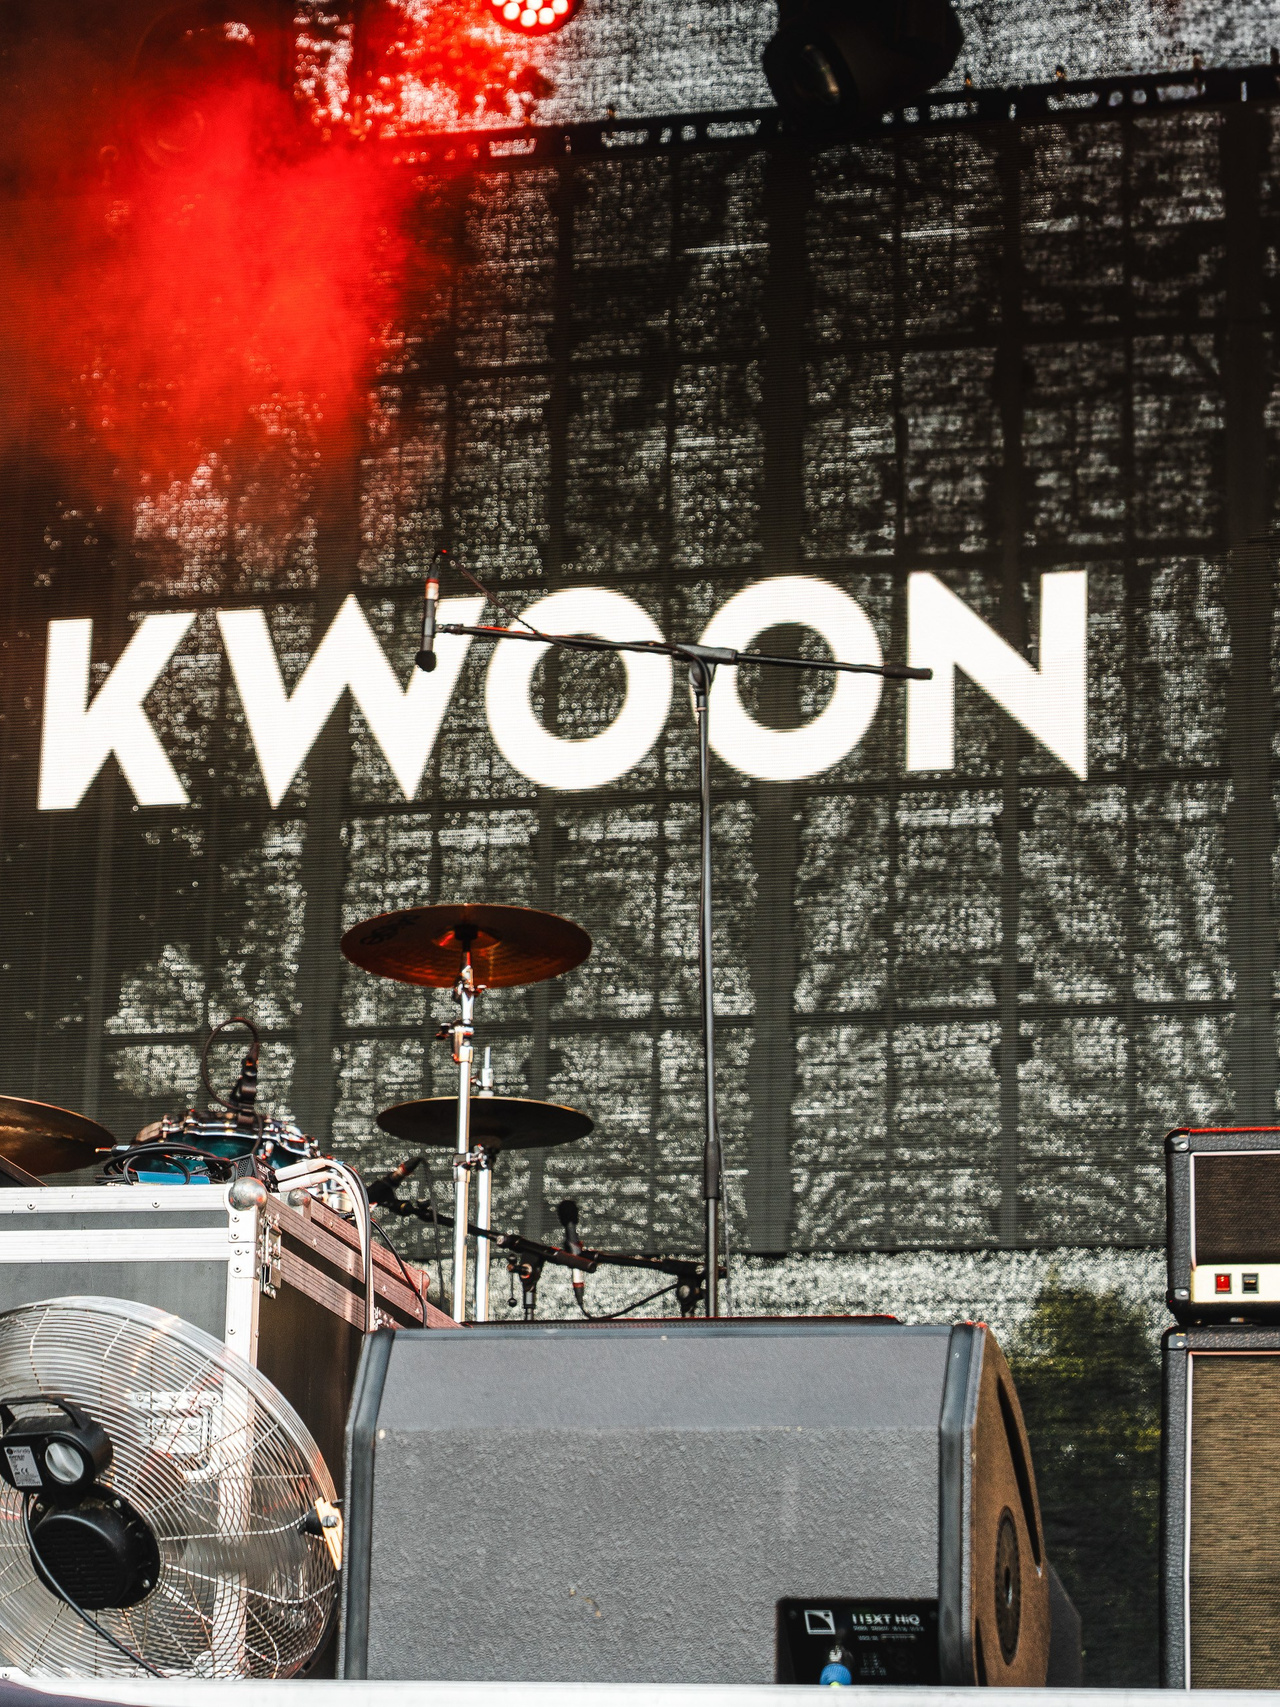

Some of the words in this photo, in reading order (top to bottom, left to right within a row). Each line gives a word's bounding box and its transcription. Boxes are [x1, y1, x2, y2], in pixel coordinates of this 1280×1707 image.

[37, 568, 1089, 810] KWOON
[852, 1613, 891, 1625] 115XT
[894, 1613, 920, 1626] HiQ
